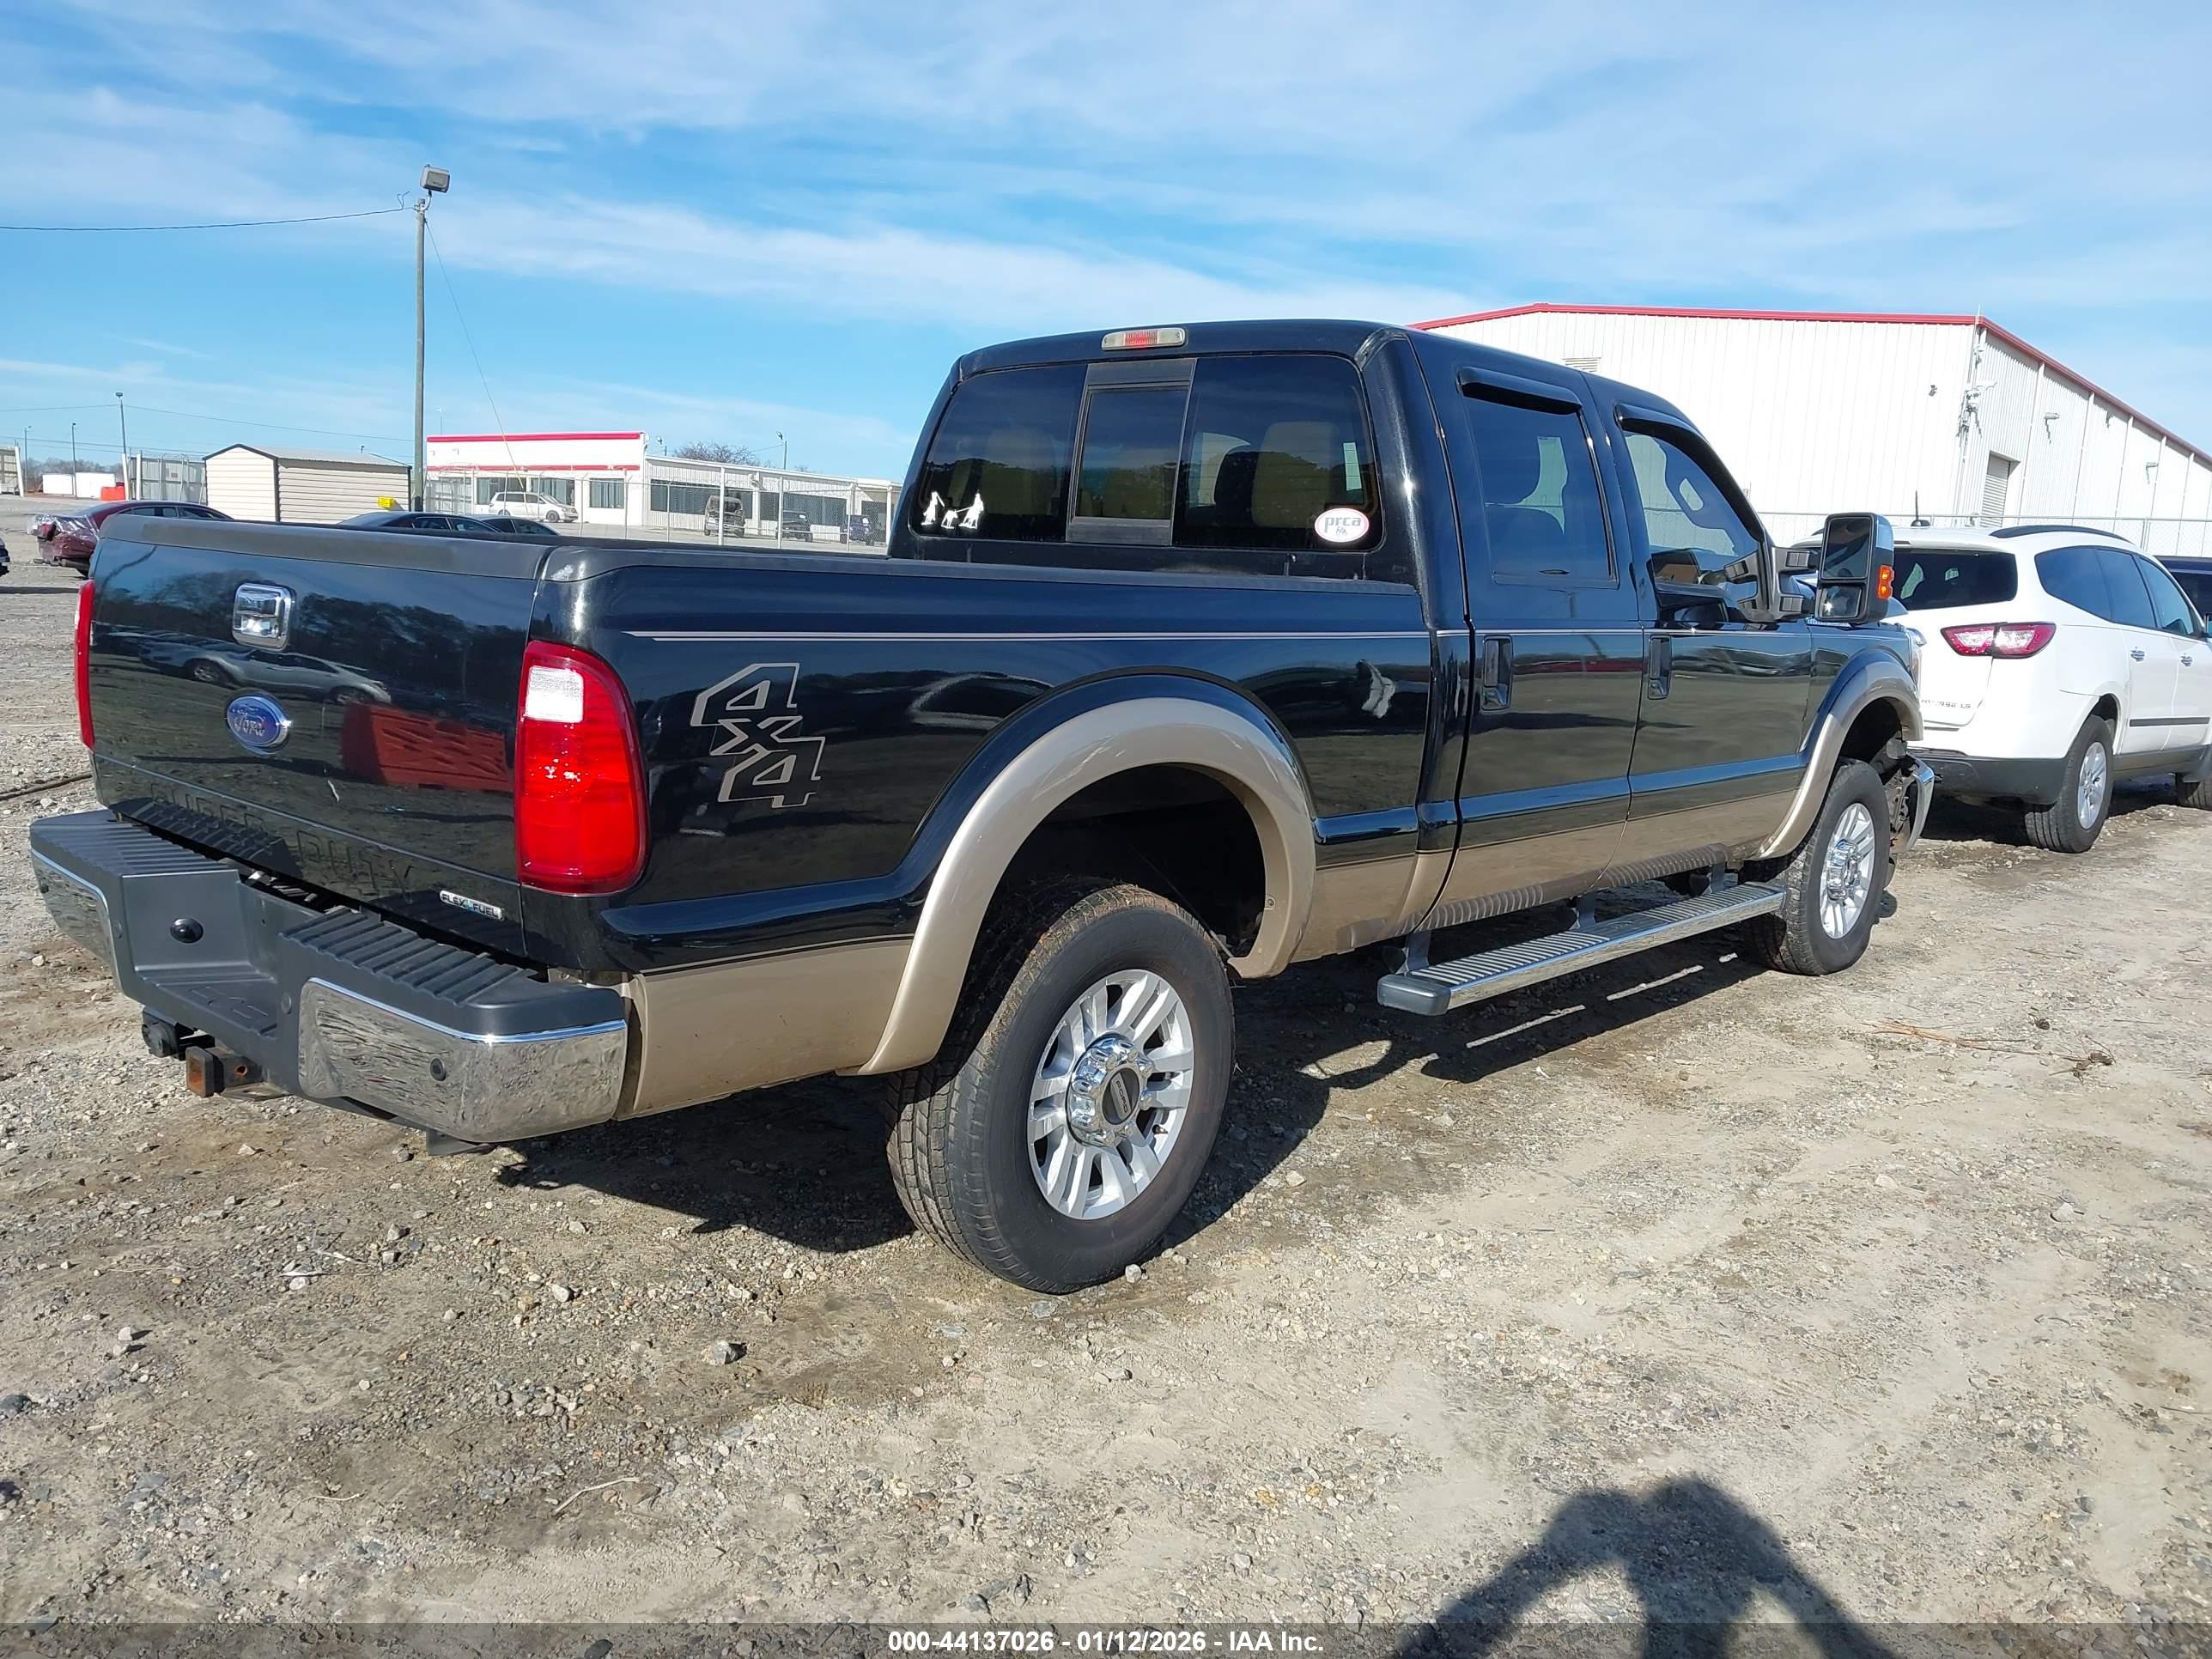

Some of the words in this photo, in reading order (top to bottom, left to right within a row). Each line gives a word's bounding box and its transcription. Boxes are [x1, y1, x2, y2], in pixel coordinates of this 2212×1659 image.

[1324, 517, 1362, 533] prca
[296, 830, 415, 904] DUTY
[441, 893, 466, 908] FLEX
[472, 902, 499, 918] FUEL
[1115, 1080, 1128, 1114] FORD
